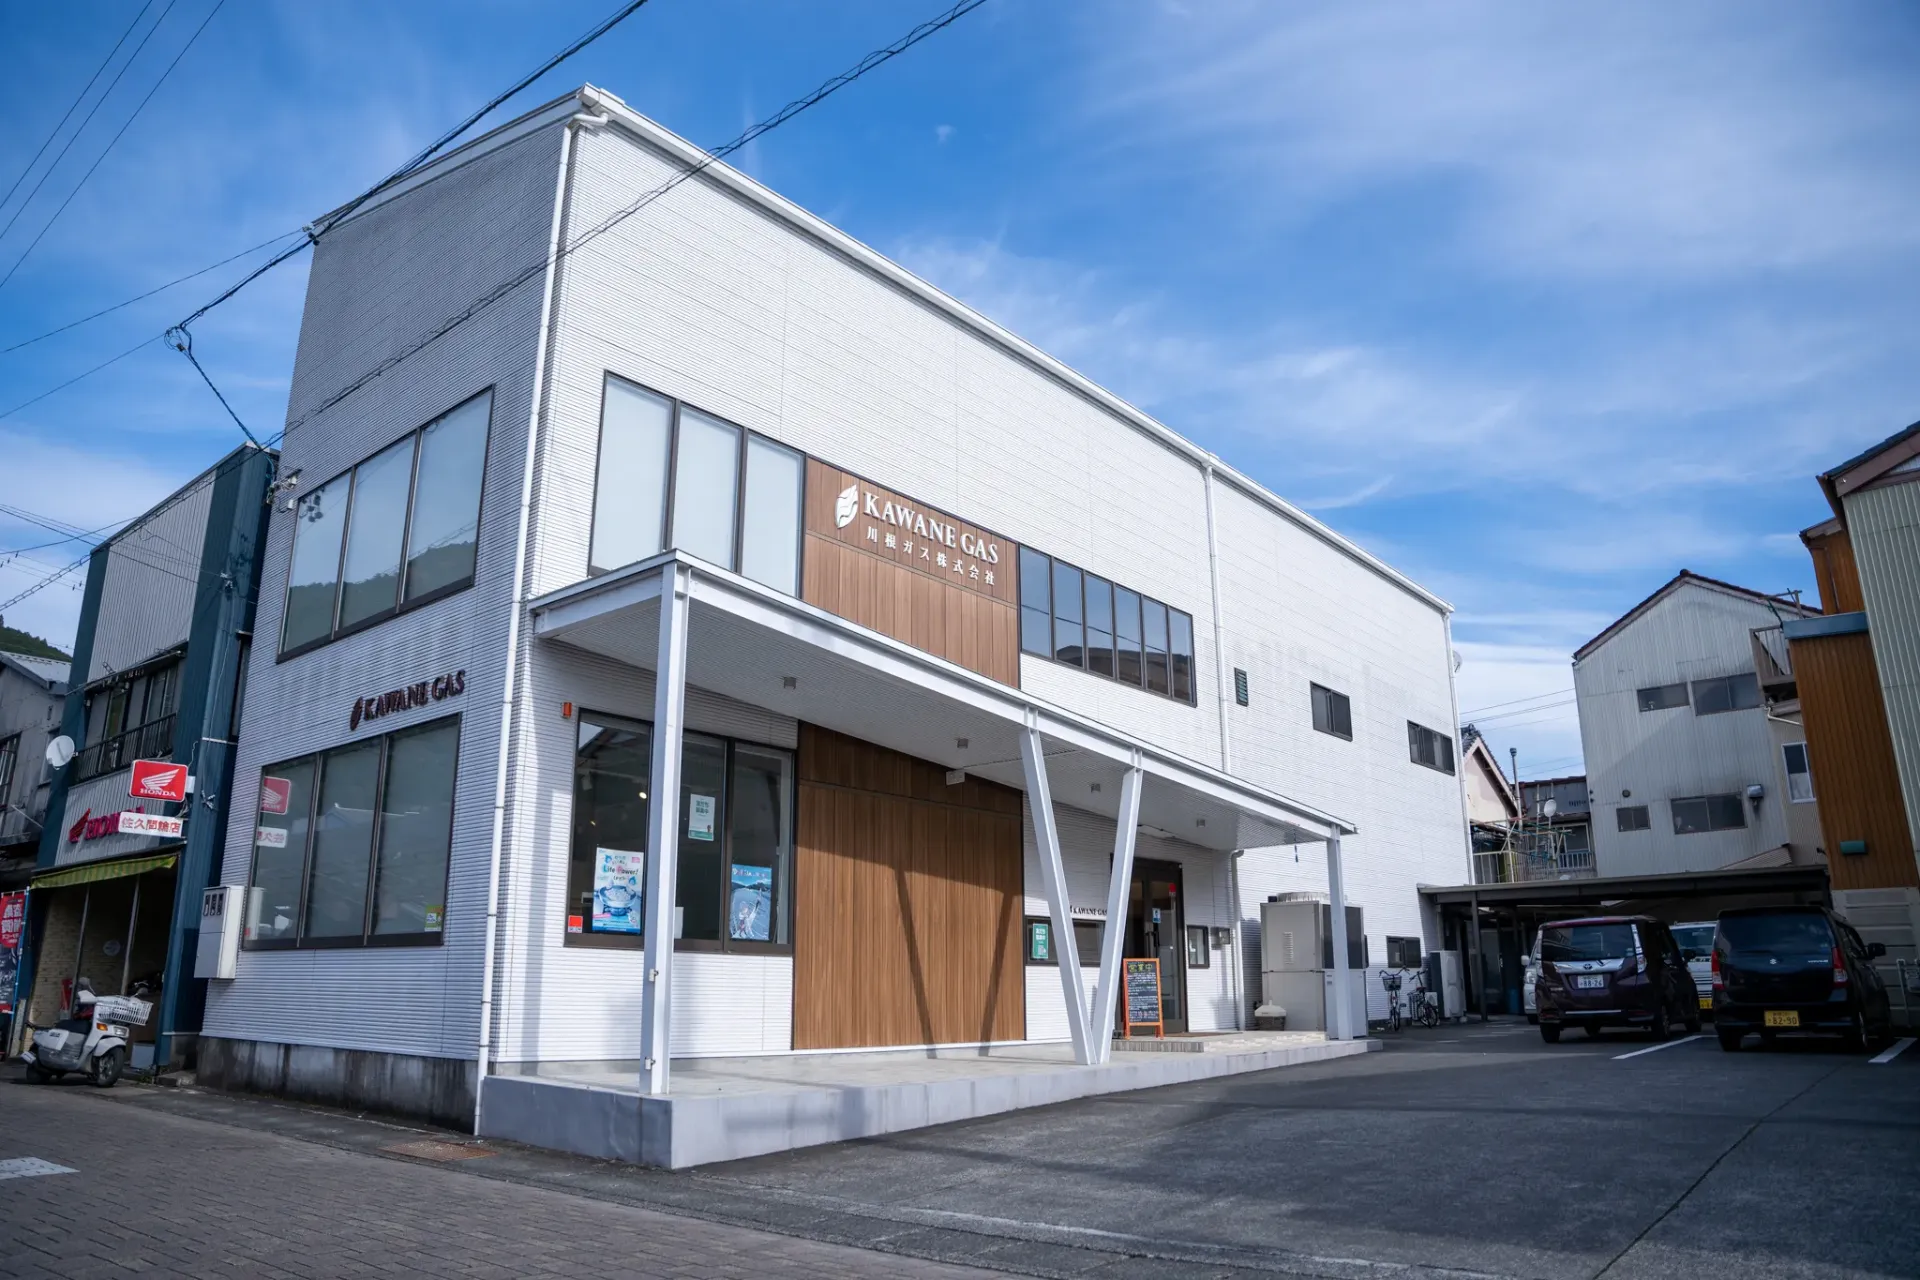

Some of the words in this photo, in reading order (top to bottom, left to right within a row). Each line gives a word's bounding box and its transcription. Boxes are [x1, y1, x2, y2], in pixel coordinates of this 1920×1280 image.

[864, 491, 956, 549] KAWANE
[960, 533, 999, 564] GAS
[867, 526, 995, 586] 川根ガス株式会社
[364, 681, 429, 720] KAWANE
[432, 669, 466, 701] GAS
[140, 788, 176, 797] HONDA
[603, 864, 615, 873] Life
